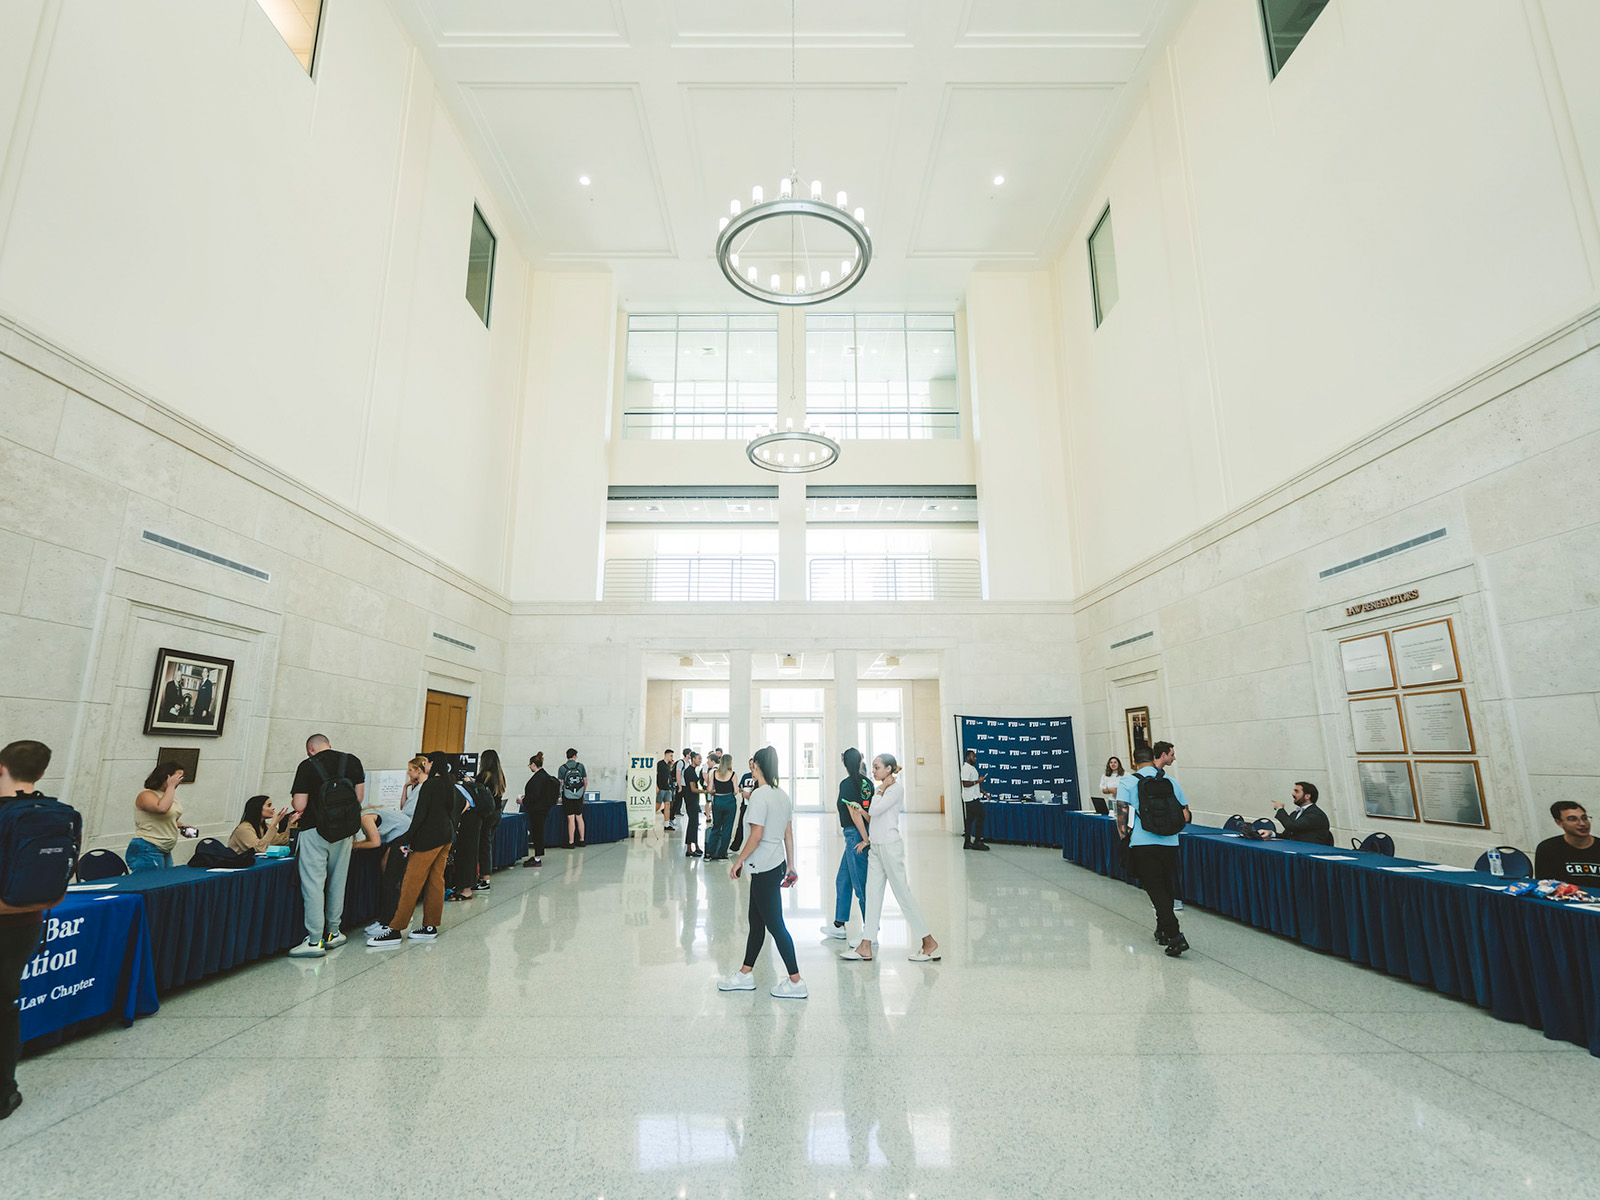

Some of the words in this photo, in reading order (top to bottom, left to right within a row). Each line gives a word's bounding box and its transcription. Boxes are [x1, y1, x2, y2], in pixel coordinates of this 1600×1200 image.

[1346, 604, 1362, 616] LAW
[1363, 588, 1420, 612] BENEFACTORS
[631, 758, 654, 768] FIU
[630, 796, 652, 806] ILSA
[40, 917, 84, 944] Bar
[20, 994, 47, 1011] Law
[50, 978, 96, 1000] Chapter
